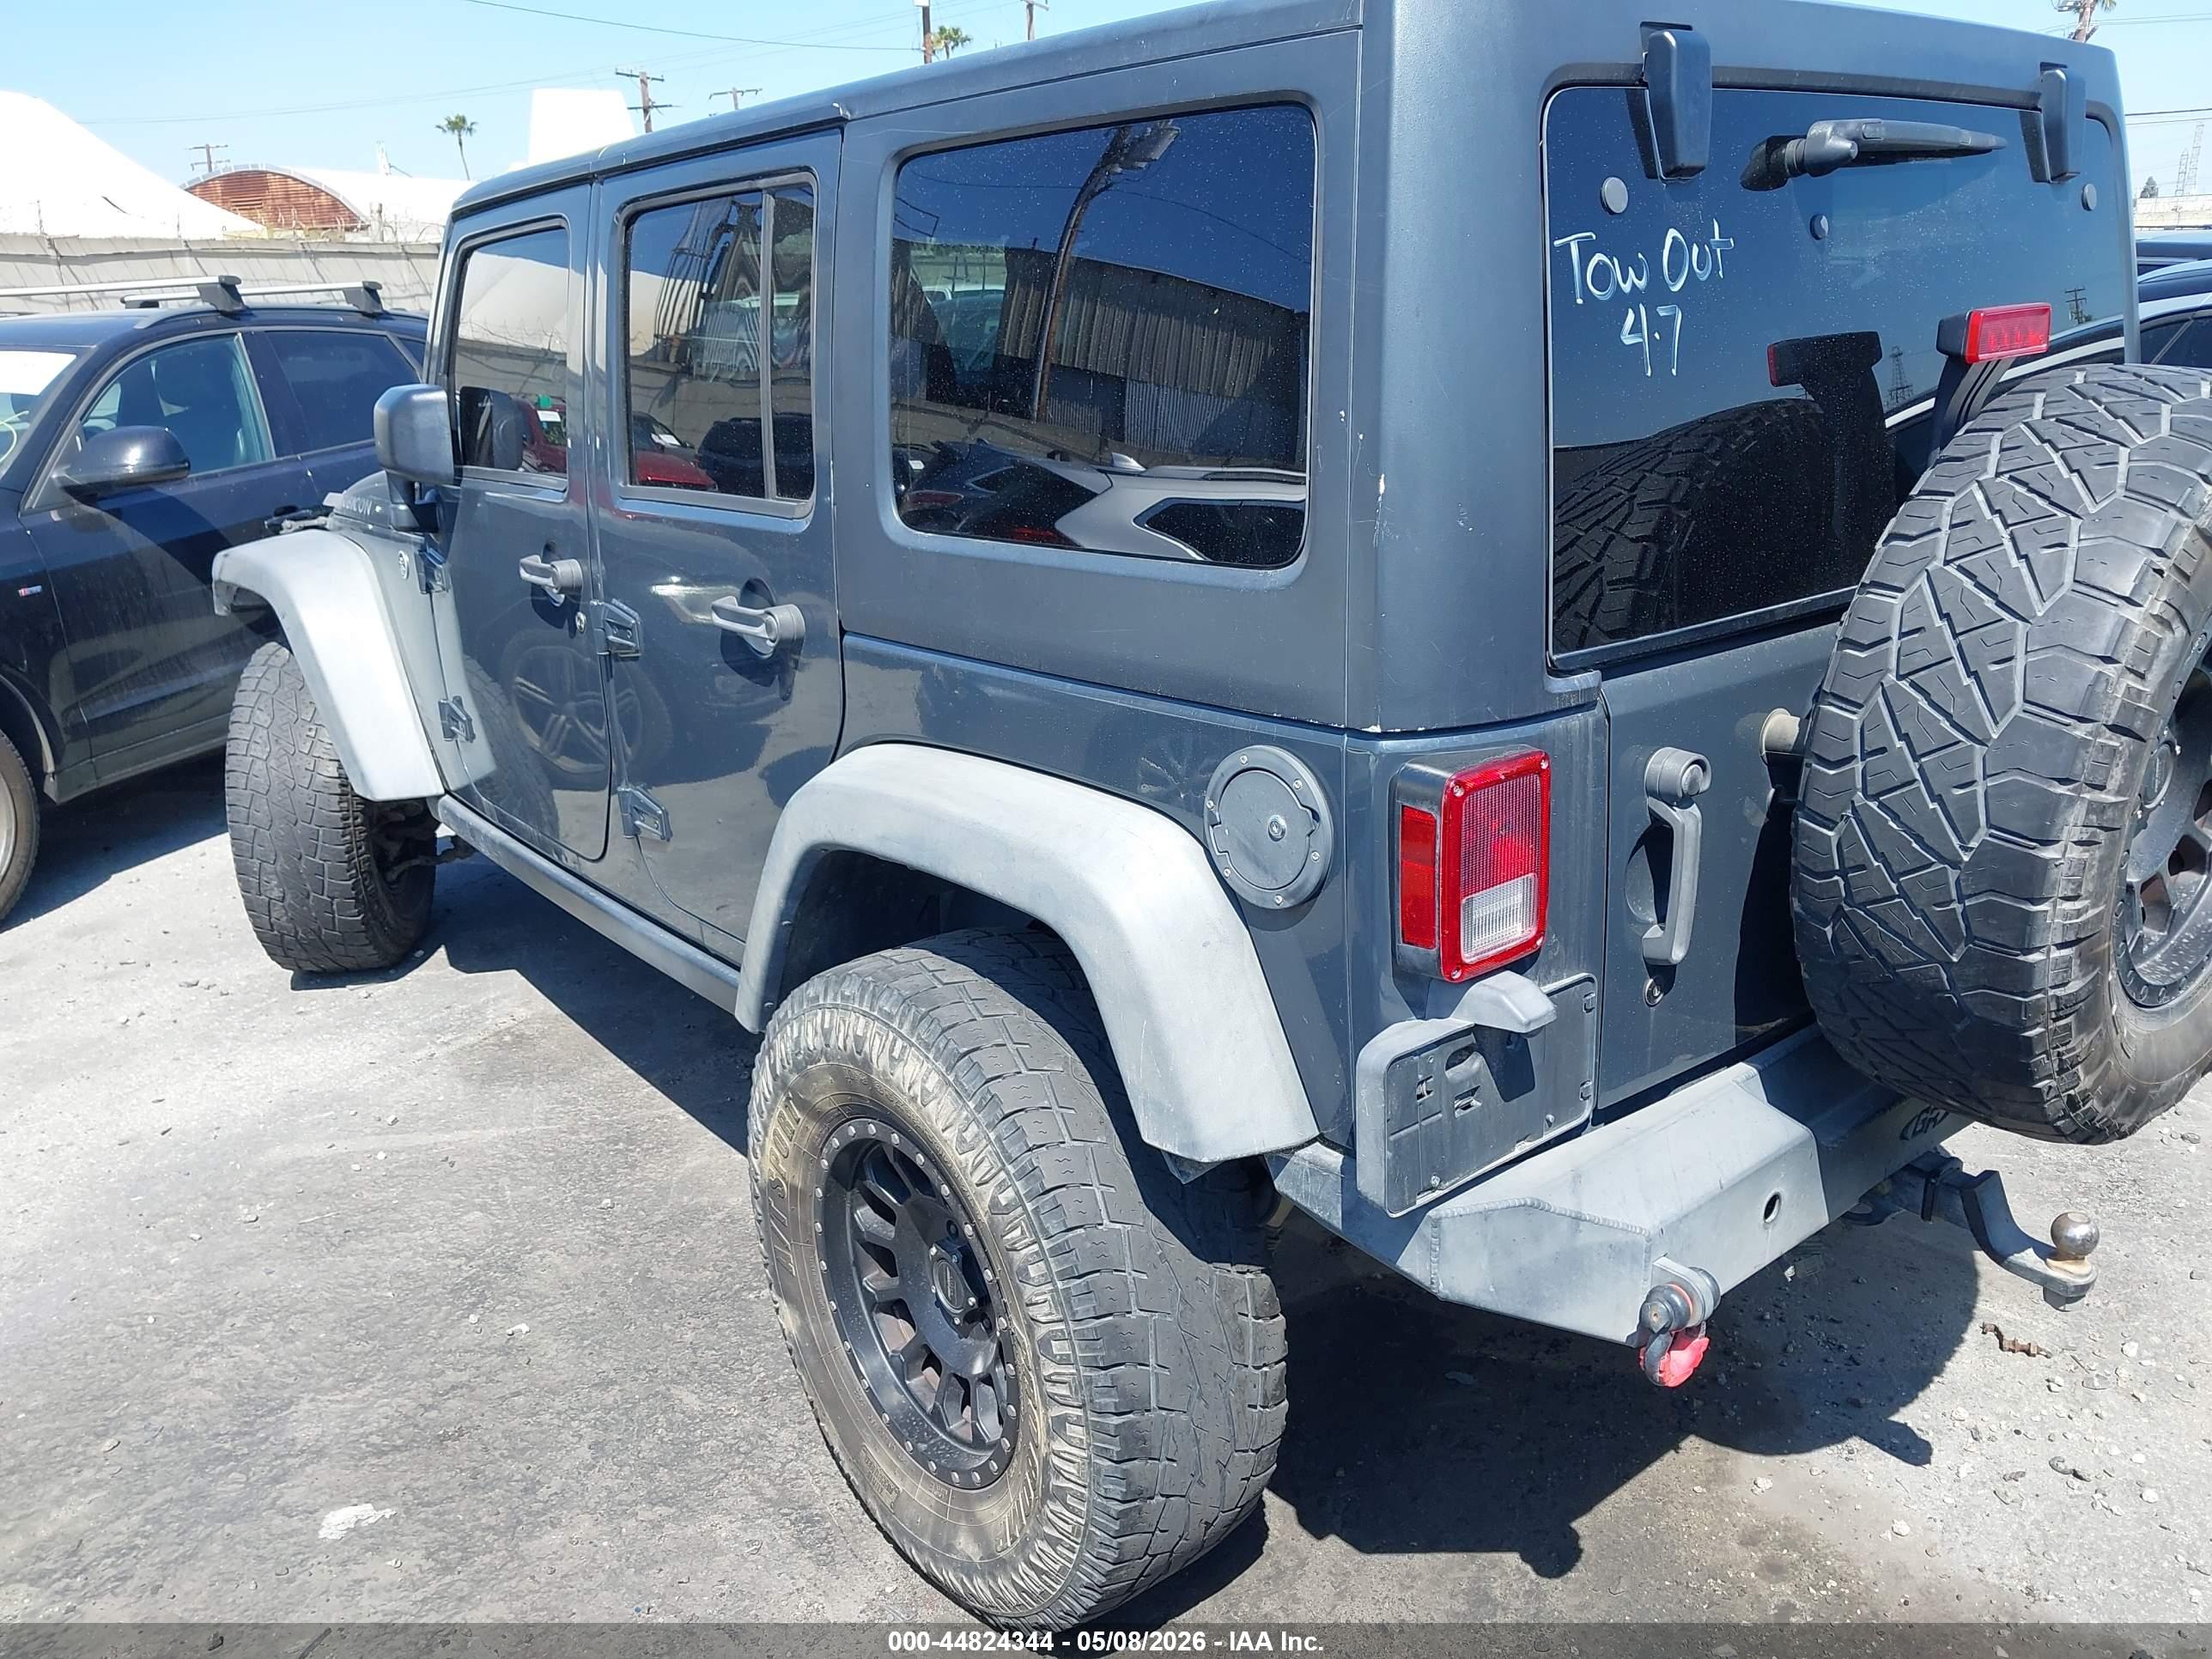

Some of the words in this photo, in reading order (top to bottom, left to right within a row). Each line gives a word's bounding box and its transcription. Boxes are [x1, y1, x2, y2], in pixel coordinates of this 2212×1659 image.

[1553, 231, 1650, 304] Tow
[1662, 218, 1735, 292] Out
[768, 1091, 800, 1199] SPORT
